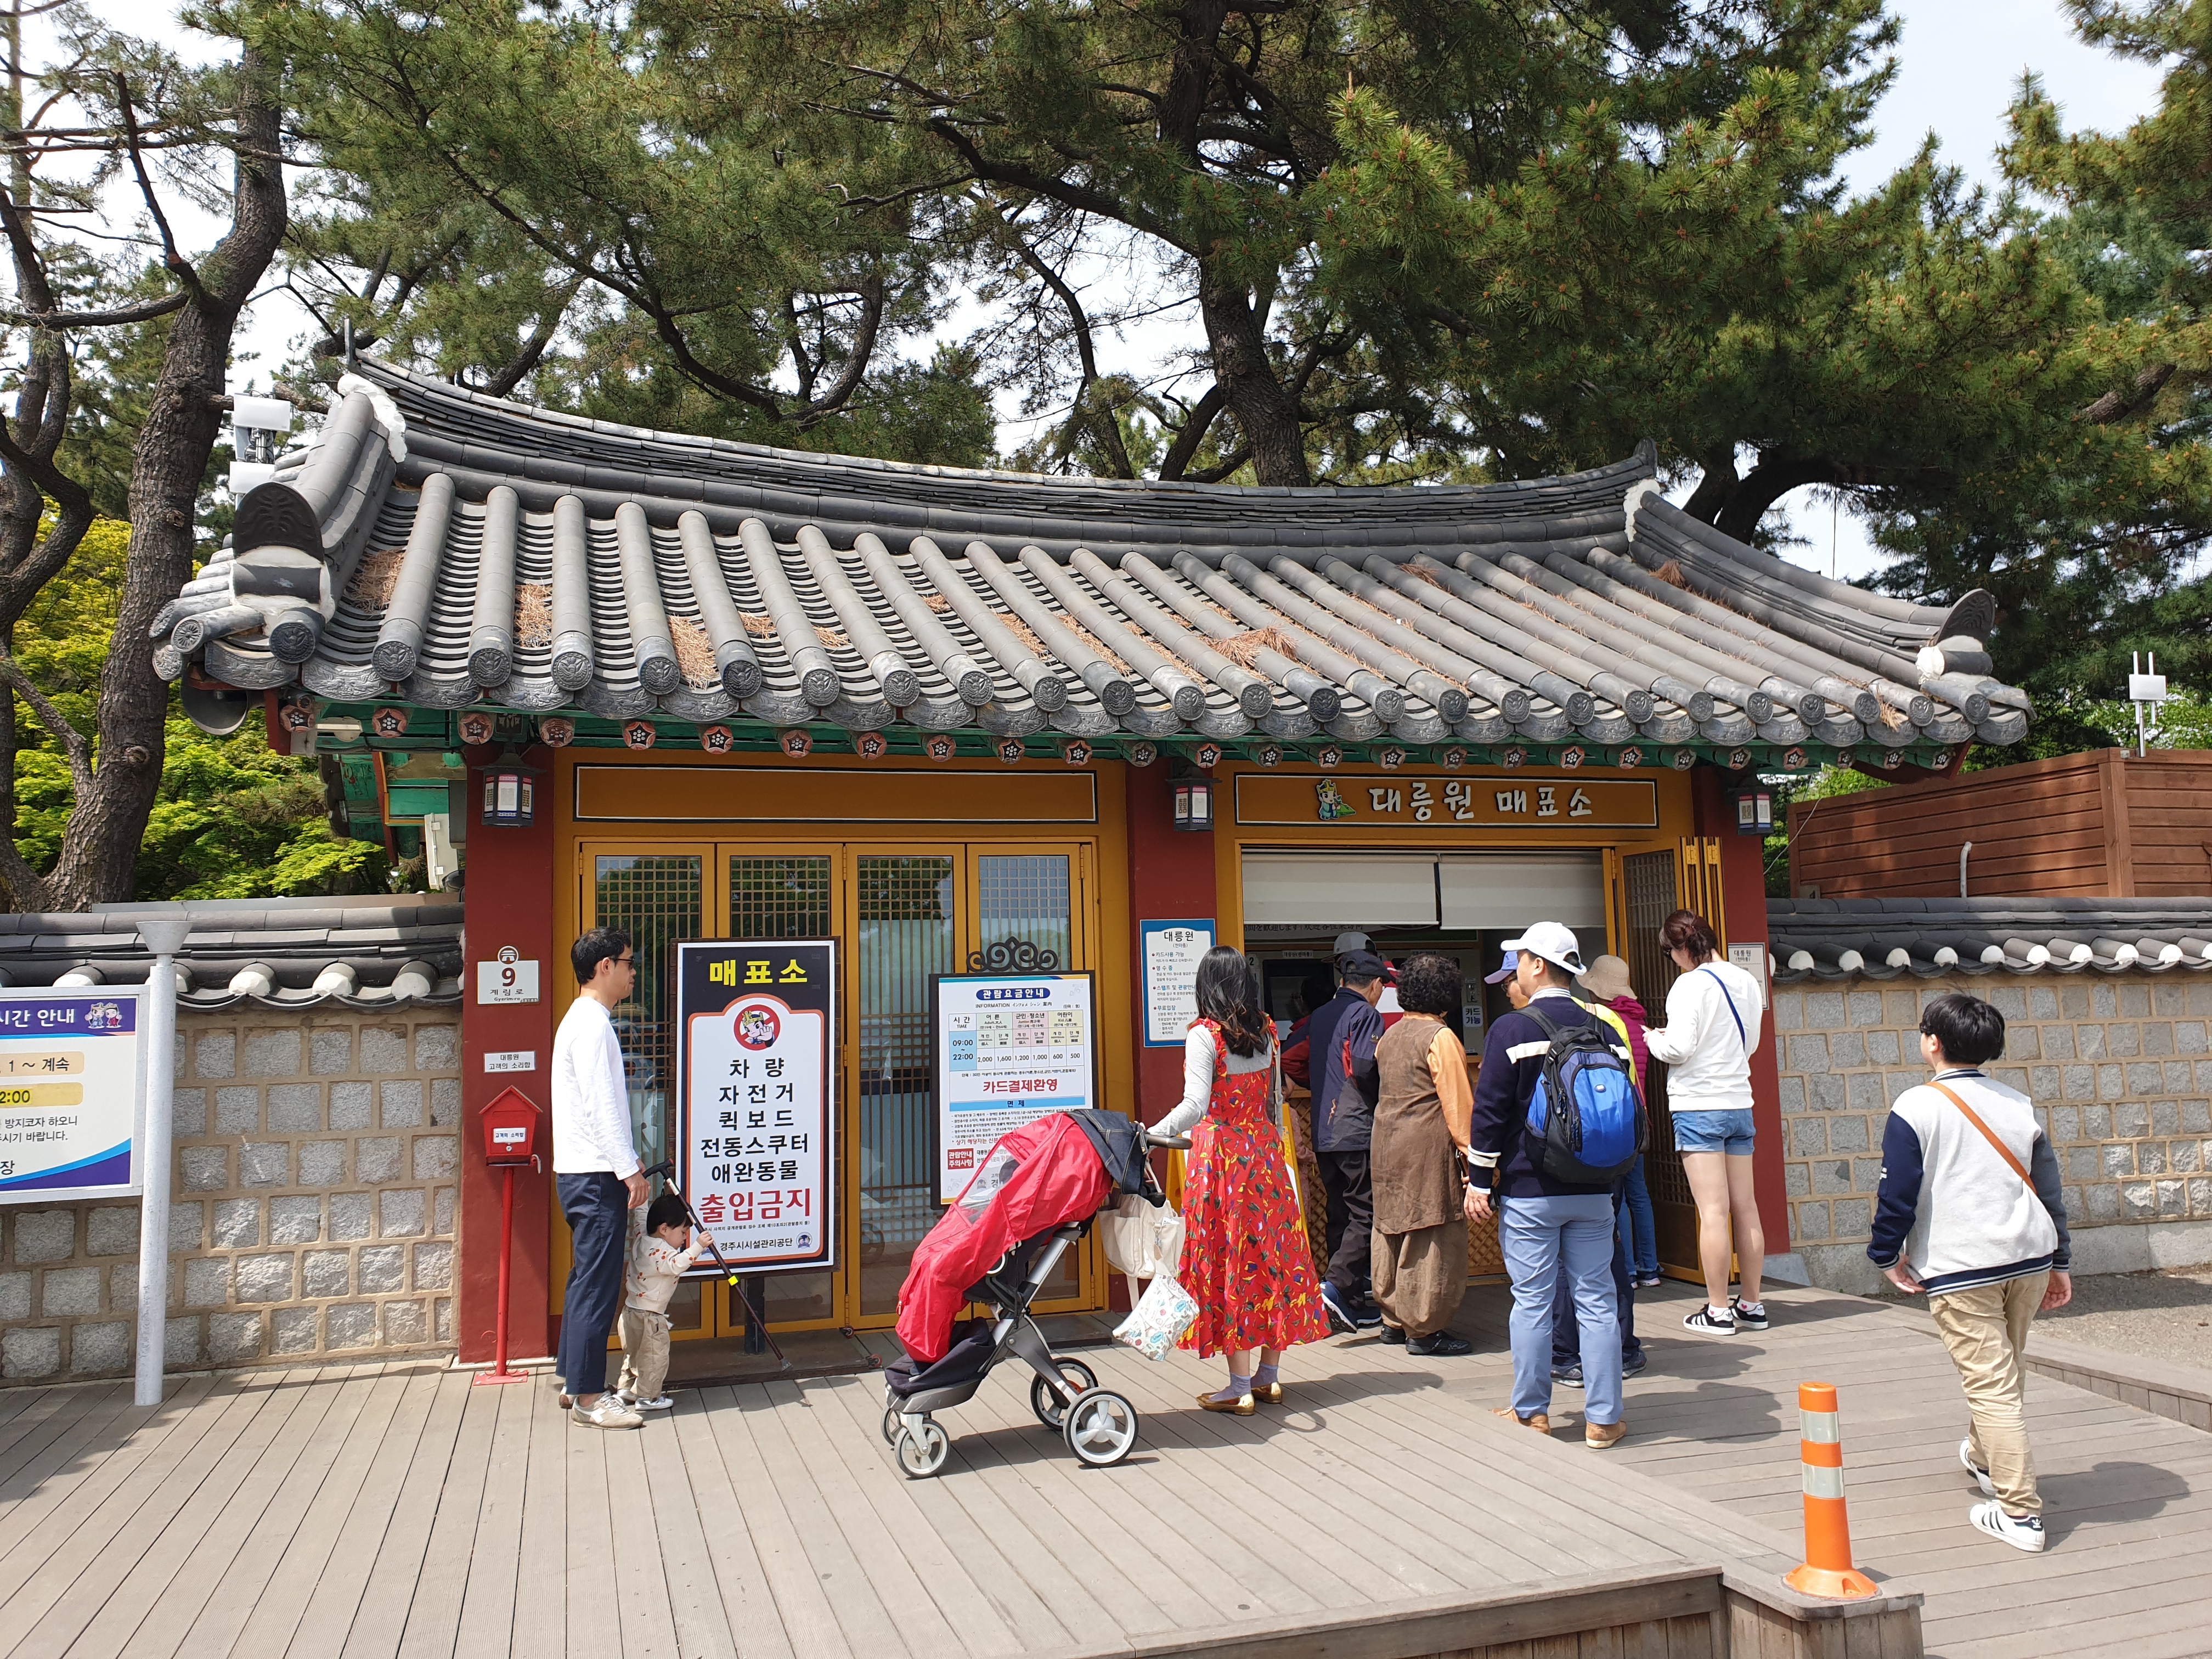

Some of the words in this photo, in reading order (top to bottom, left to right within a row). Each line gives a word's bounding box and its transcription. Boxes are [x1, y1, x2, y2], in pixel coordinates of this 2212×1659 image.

[1369, 782, 1474, 821] 대릉원
[1497, 788, 1592, 817] 매표소
[1164, 931, 1193, 942] 대릉원
[1249, 957, 1254, 966] 2
[501, 967, 516, 987] 9
[709, 959, 808, 986] 매표소
[983, 989, 1045, 999] 관람요금안내
[37, 1008, 75, 1027] 안내
[1466, 1016, 1481, 1024] 가능
[9, 1060, 14, 1073] 1
[42, 1057, 70, 1071] 계속
[983, 1078, 1058, 1093] 카드결제환영
[719, 1082, 793, 1105] 자전거
[5, 1117, 45, 1128] 방지코자
[48, 1115, 78, 1126] 하오니
[719, 1109, 794, 1131] 퀵보드
[0, 1132, 21, 1143] 시기
[26, 1131, 68, 1142] 바랍니다.
[700, 1133, 808, 1158] 전동스쿠터
[949, 1151, 972, 1159] 관람안내
[949, 1159, 972, 1167] 주의사항
[712, 1160, 799, 1184] 애완동물
[698, 1188, 810, 1223] 출입금지
[720, 1238, 793, 1251] 경주시시설관리공단
